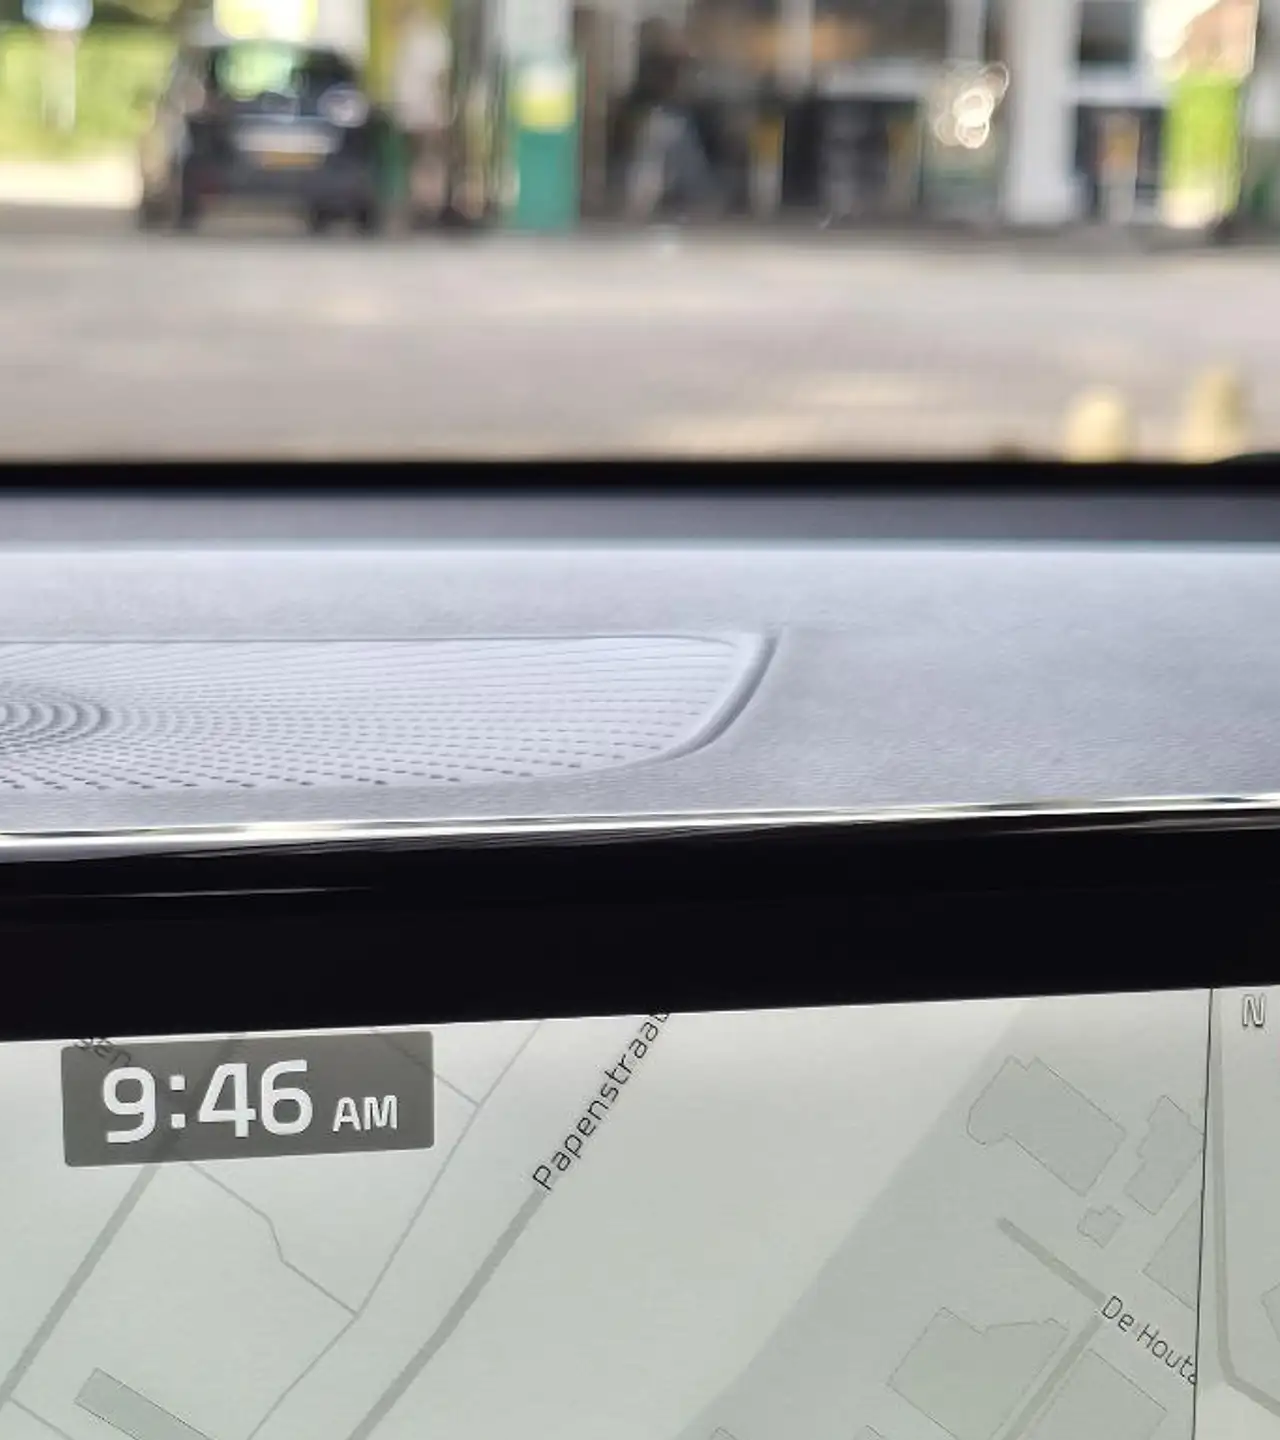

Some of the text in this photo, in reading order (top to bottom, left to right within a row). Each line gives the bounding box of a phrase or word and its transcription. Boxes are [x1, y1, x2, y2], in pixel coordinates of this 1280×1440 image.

[1240, 994, 1265, 1027] N
[102, 1059, 398, 1143] 9:46 AM
[1101, 1295, 1135, 1333] De
